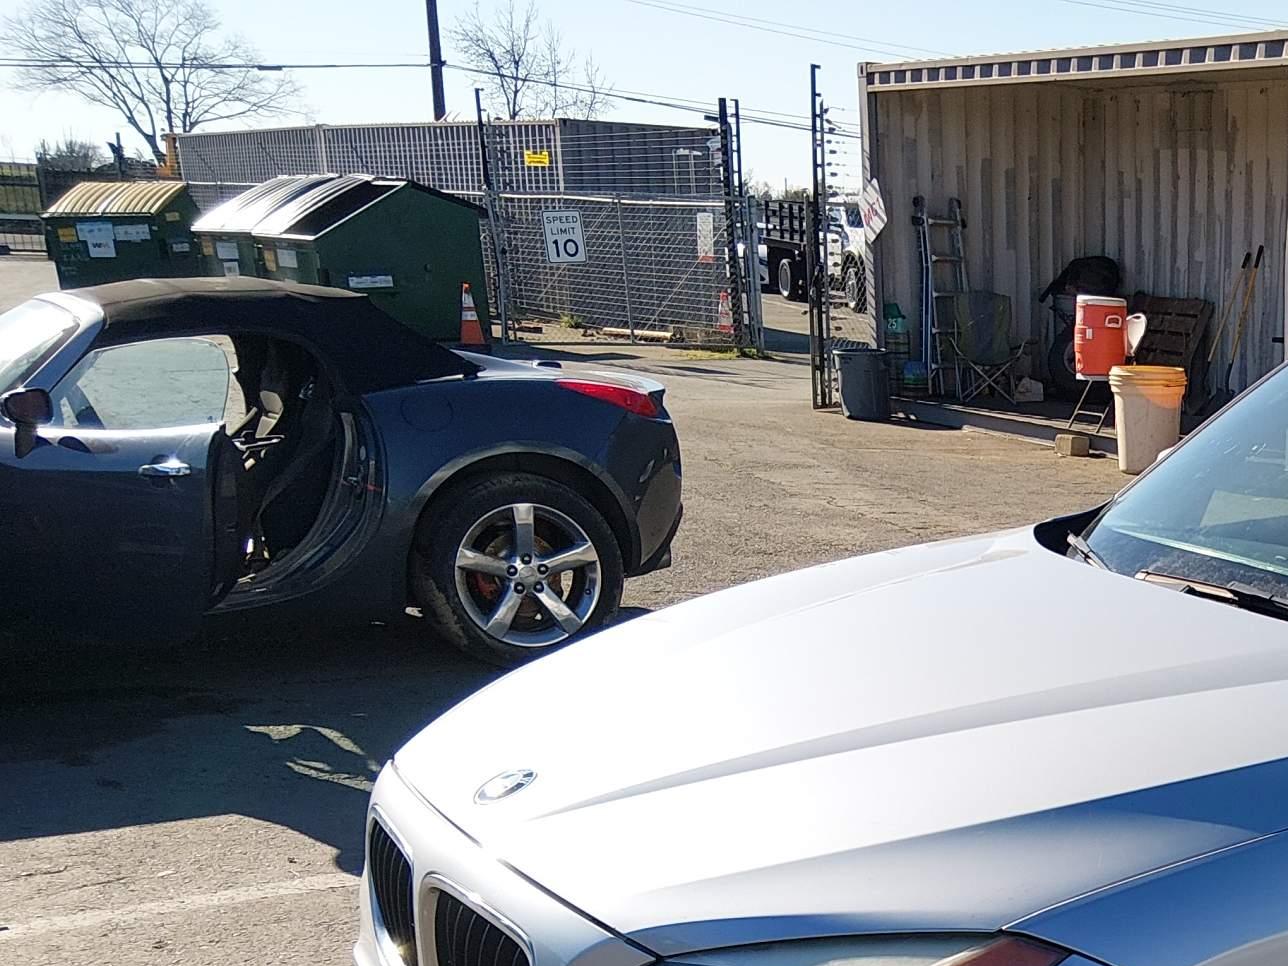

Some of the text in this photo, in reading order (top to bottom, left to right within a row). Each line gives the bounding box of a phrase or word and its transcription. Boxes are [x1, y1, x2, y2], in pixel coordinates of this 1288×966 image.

[546, 216, 578, 224] SPEED
[550, 227, 576, 235] LIMIT
[552, 239, 579, 257] 10
